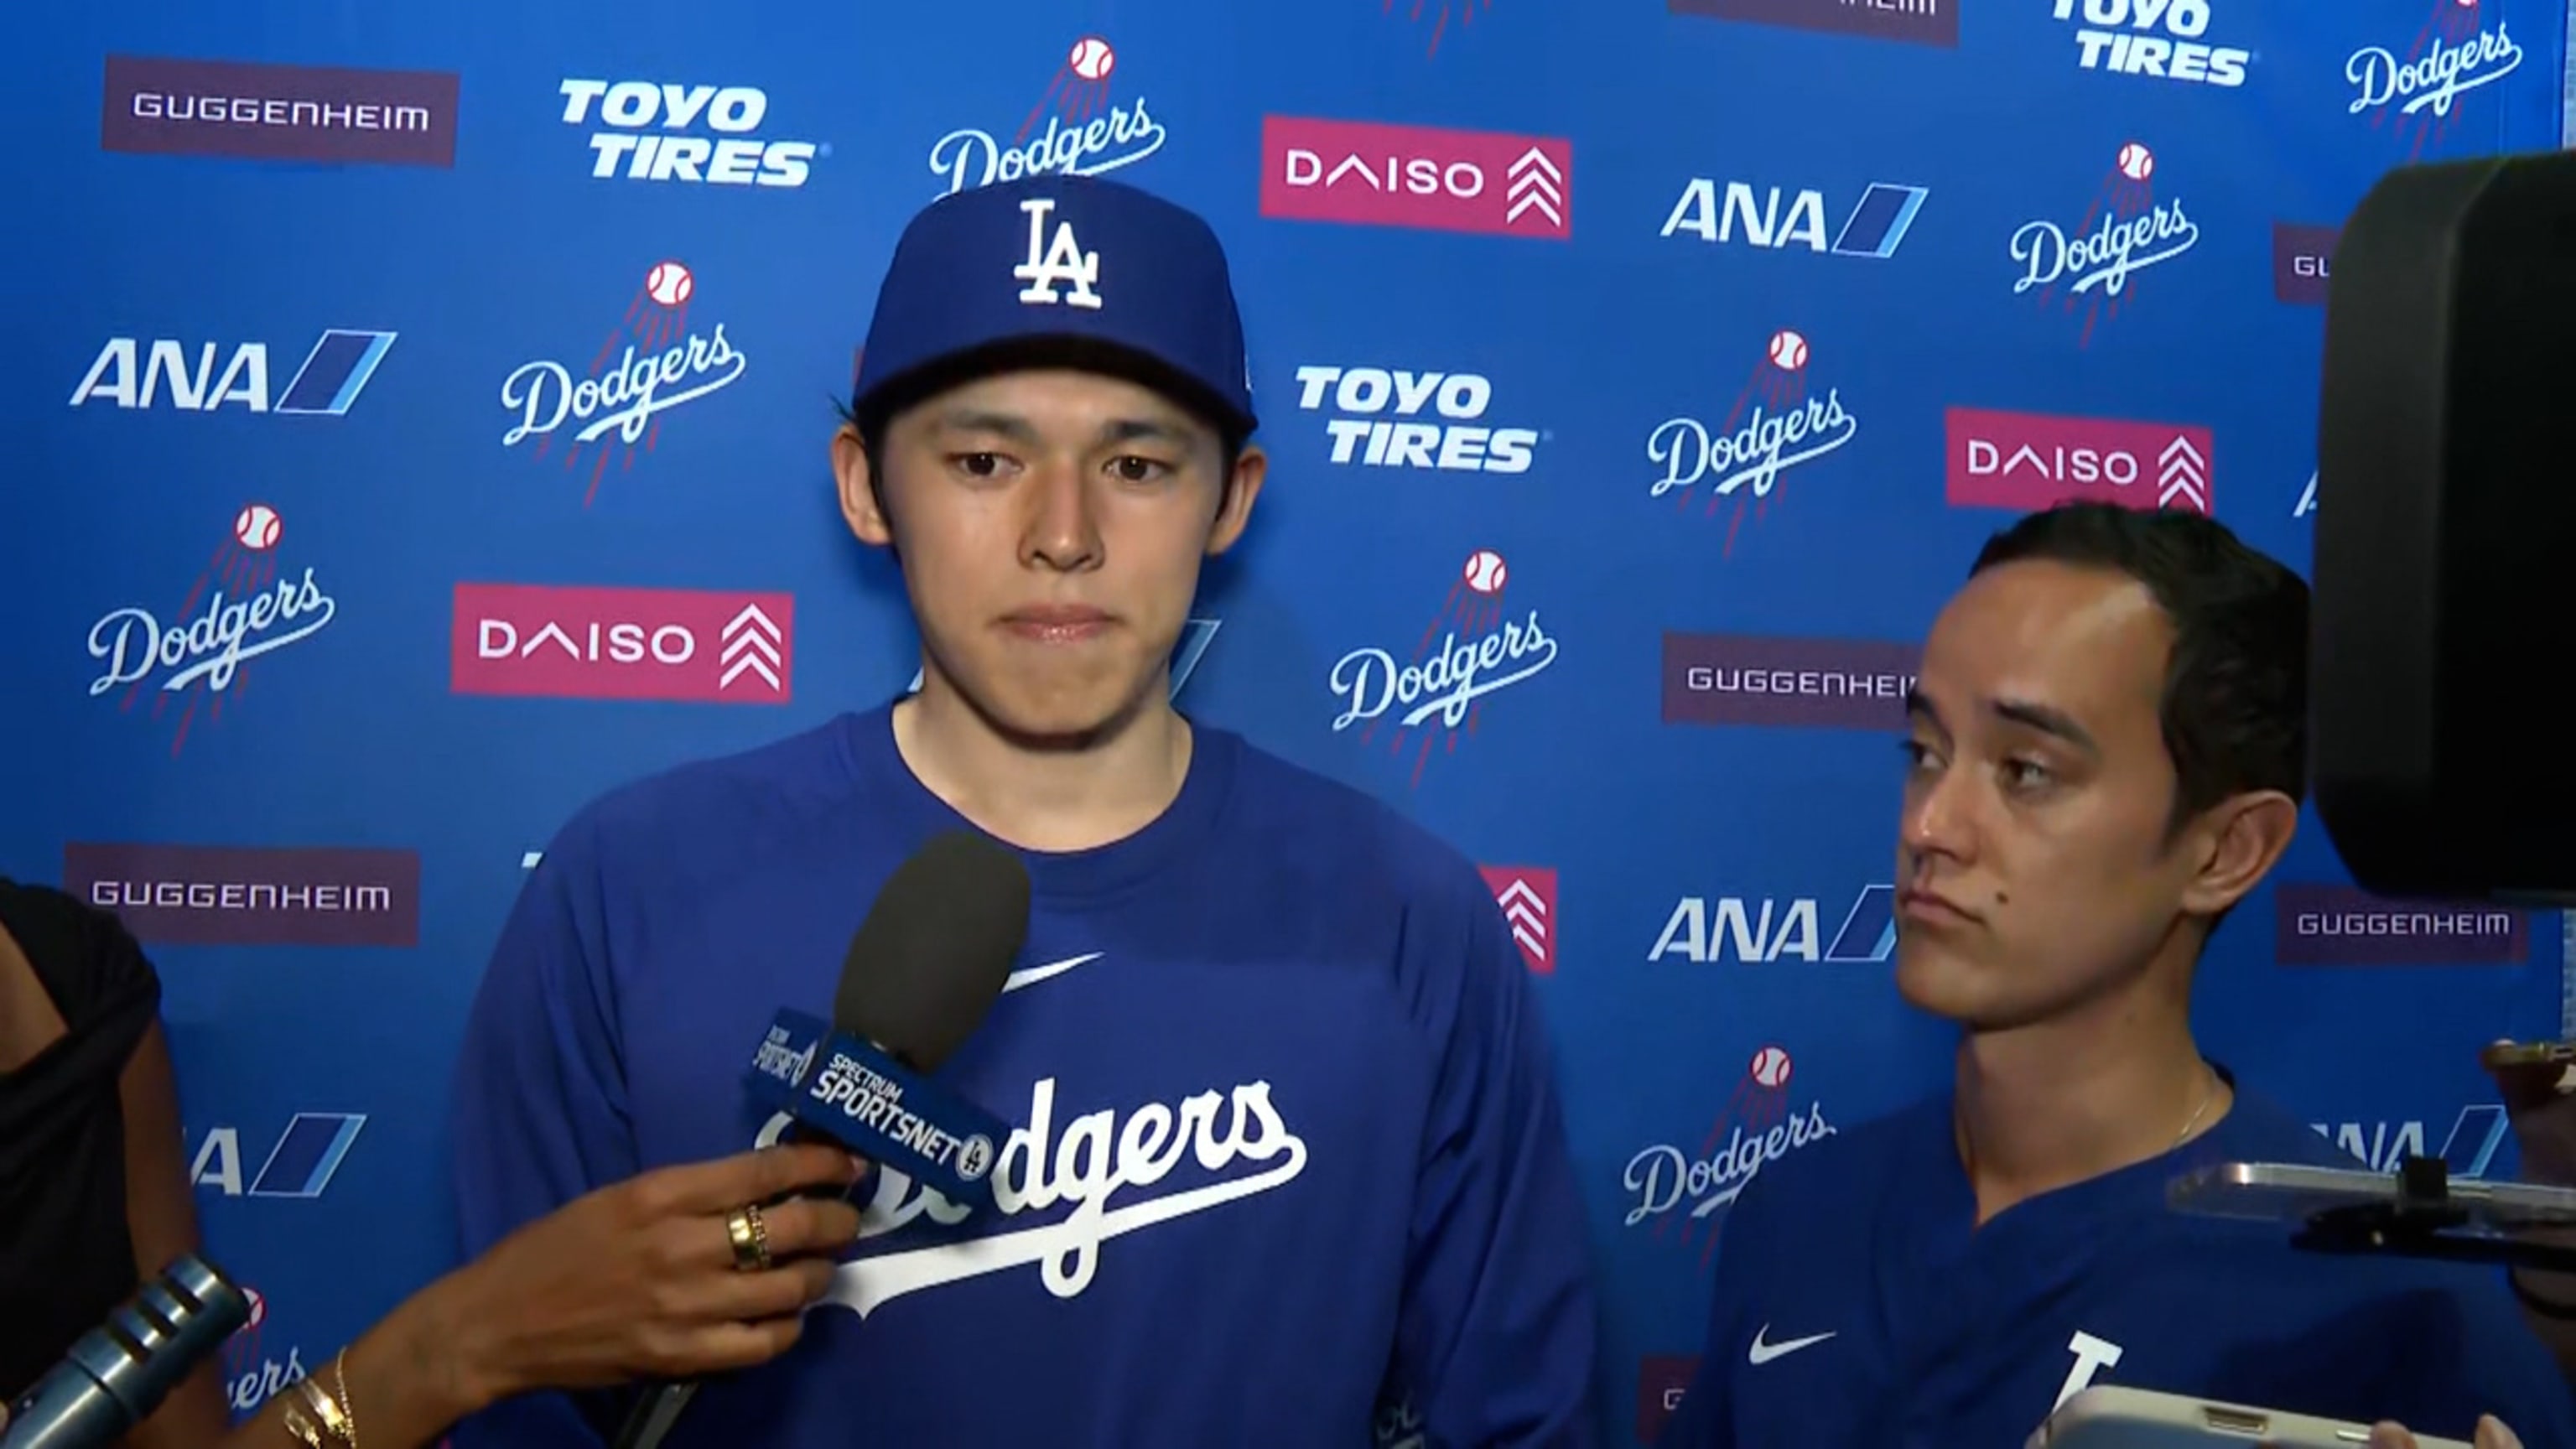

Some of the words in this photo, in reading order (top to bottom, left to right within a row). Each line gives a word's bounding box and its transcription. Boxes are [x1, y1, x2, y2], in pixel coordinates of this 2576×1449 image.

[2075, 29, 2250, 86] TIRES
[2345, 21, 2523, 117] Dodgers
[133, 92, 430, 132] GUGGENHEIM
[559, 79, 768, 132] TOYO
[589, 133, 817, 187] TIRES
[928, 96, 1166, 203] Dodgers
[1285, 148, 1485, 199] DAISO
[1660, 178, 1826, 252] ANA
[2009, 197, 2199, 297] Dodgers
[1013, 199, 1103, 309] LA
[69, 337, 270, 413] ANA
[501, 322, 747, 446] Dodgers
[1296, 366, 1491, 419] TOYO
[1327, 419, 1538, 474] TIRES
[1647, 387, 1857, 497] Dodgers
[1966, 438, 2139, 486] DAISO
[87, 567, 335, 696] Dodgers
[477, 618, 696, 665] DAISO
[1330, 610, 1558, 732] Dodgers
[91, 880, 391, 911] GUGGENHEIM
[2296, 912, 2511, 936] GUGGENHEIM
[1647, 896, 1820, 962] ANA
[828, 1052, 904, 1104] SPECTRUM
[810, 1069, 962, 1166] SPORTSNET
[2309, 1120, 2424, 1176] NA
[1623, 1100, 1838, 1227] Dodgers
[755, 1077, 1308, 1321] dgers
